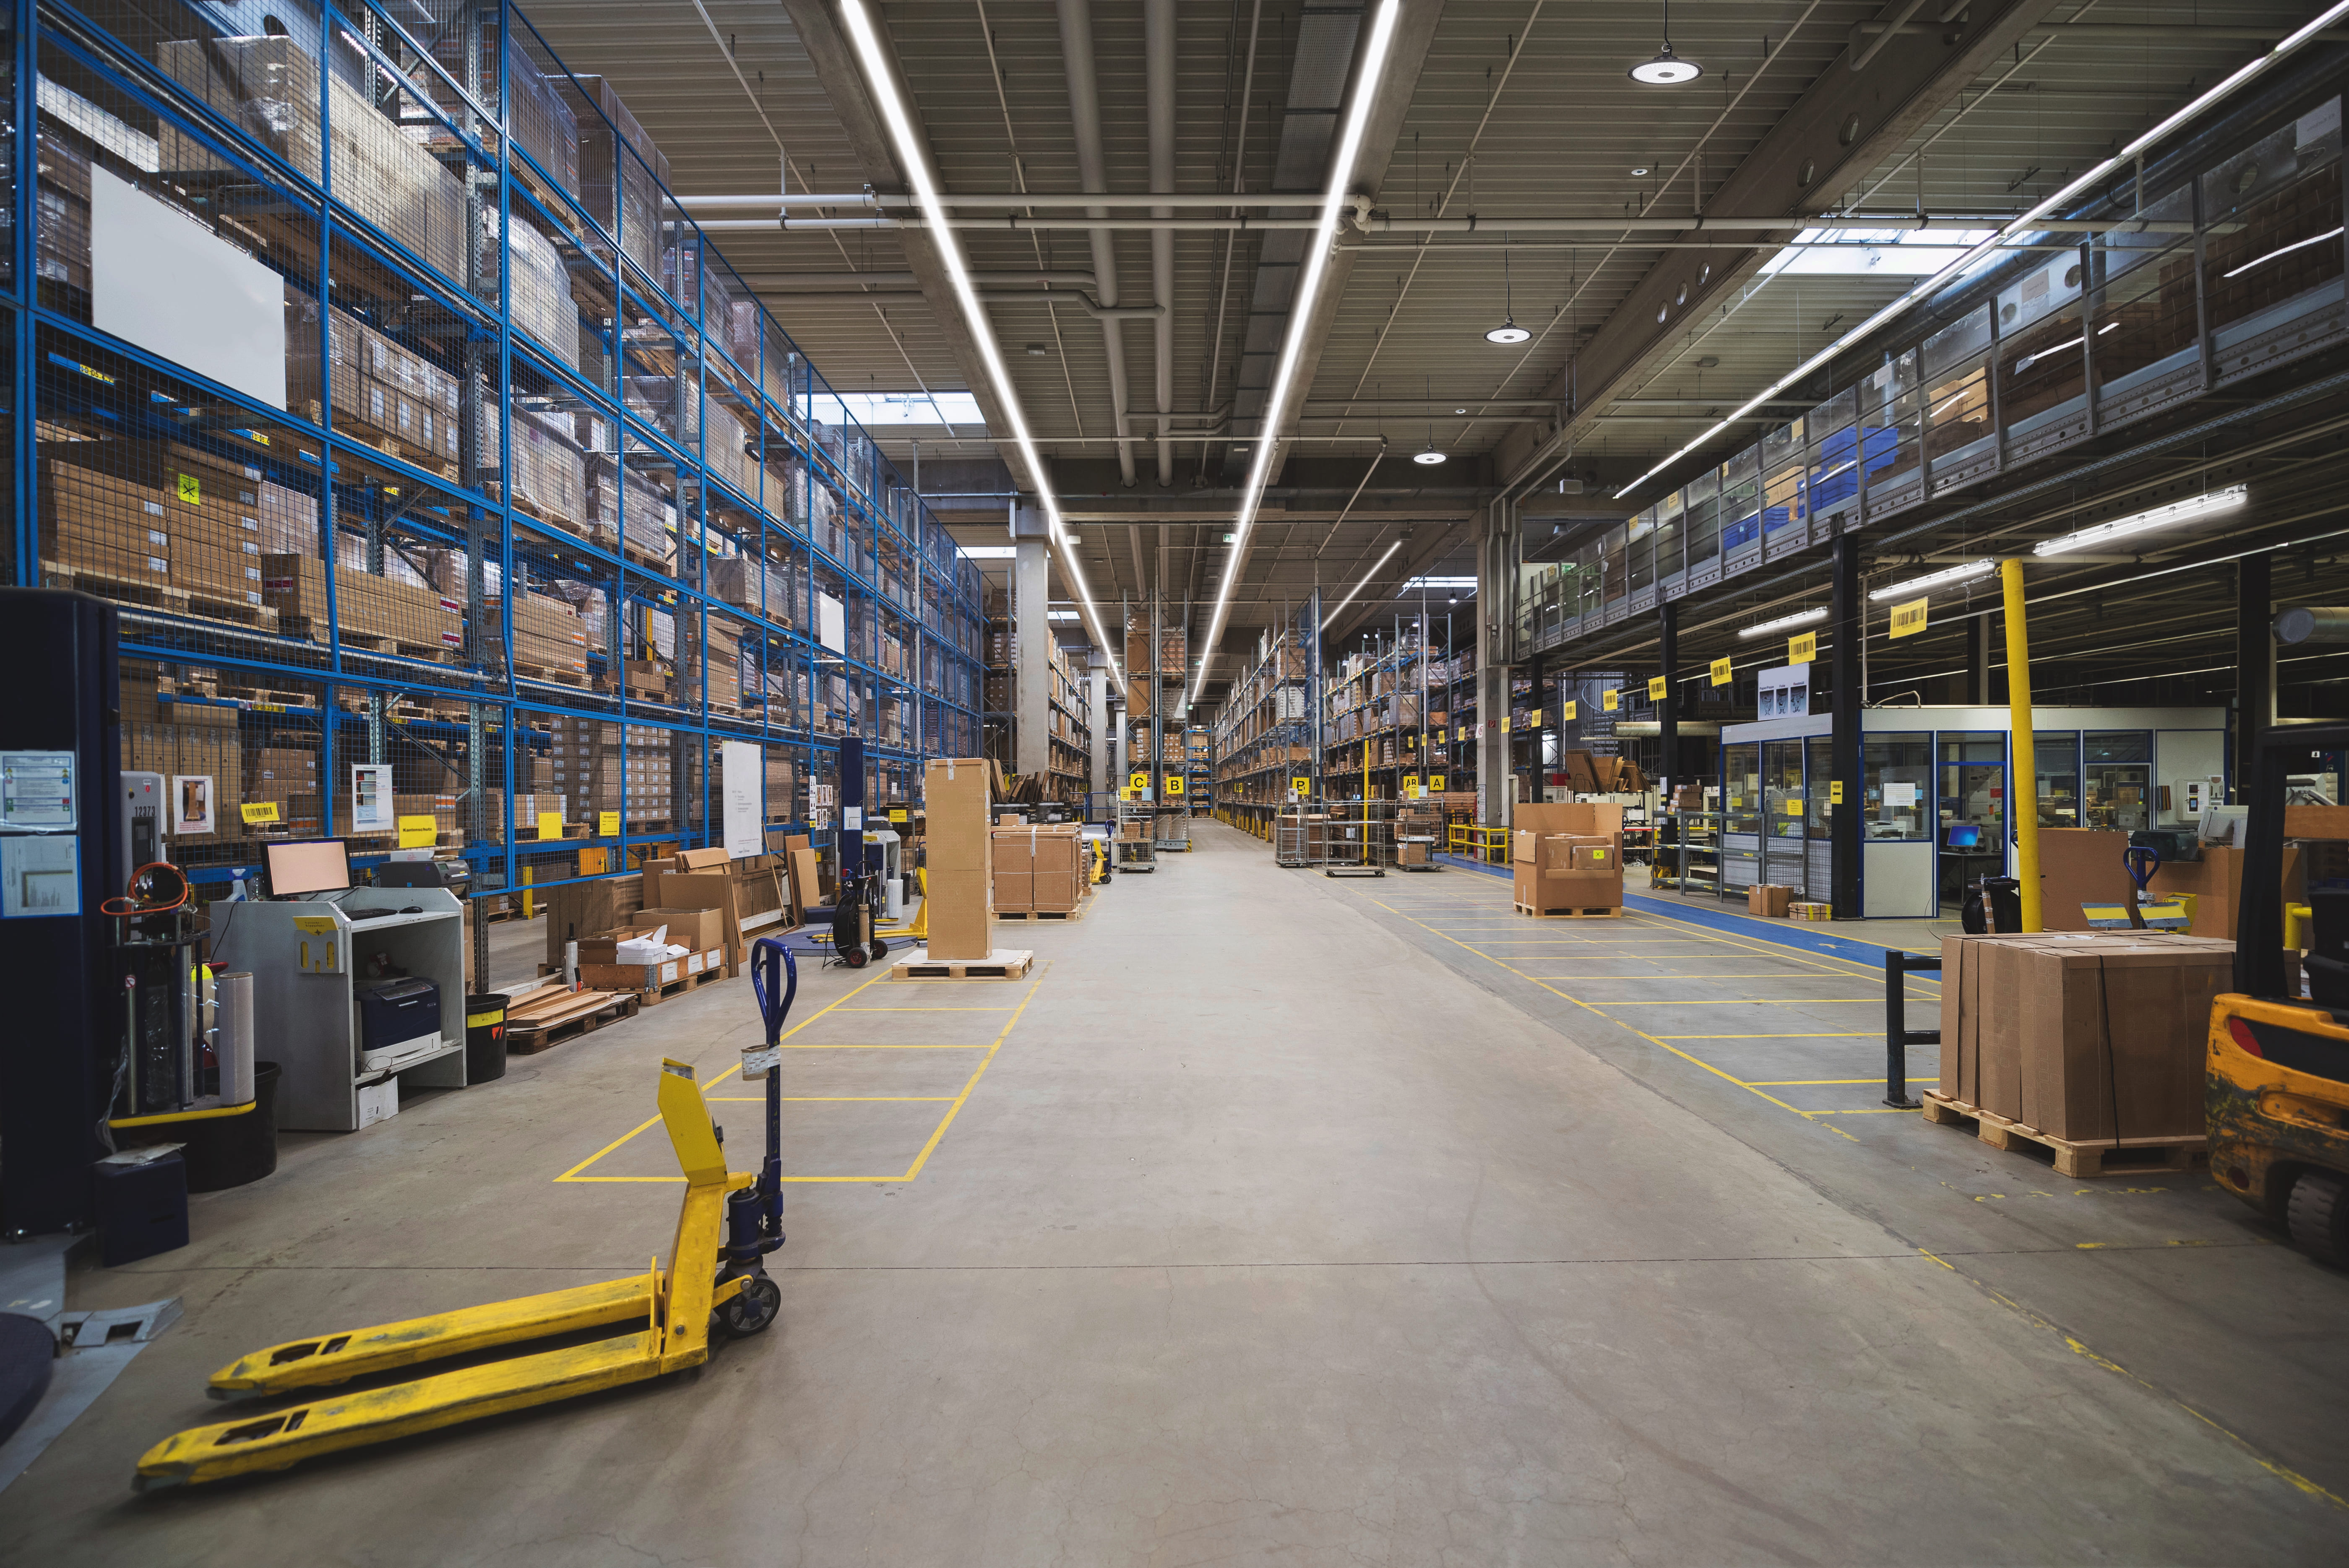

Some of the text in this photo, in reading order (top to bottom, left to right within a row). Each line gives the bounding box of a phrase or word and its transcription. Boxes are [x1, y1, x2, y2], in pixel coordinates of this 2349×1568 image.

[1134, 777, 1143, 788] C
[1170, 780, 1179, 790] B
[1297, 781, 1305, 791] B
[1433, 778, 1441, 787] A
[135, 806, 155, 817] 12373
